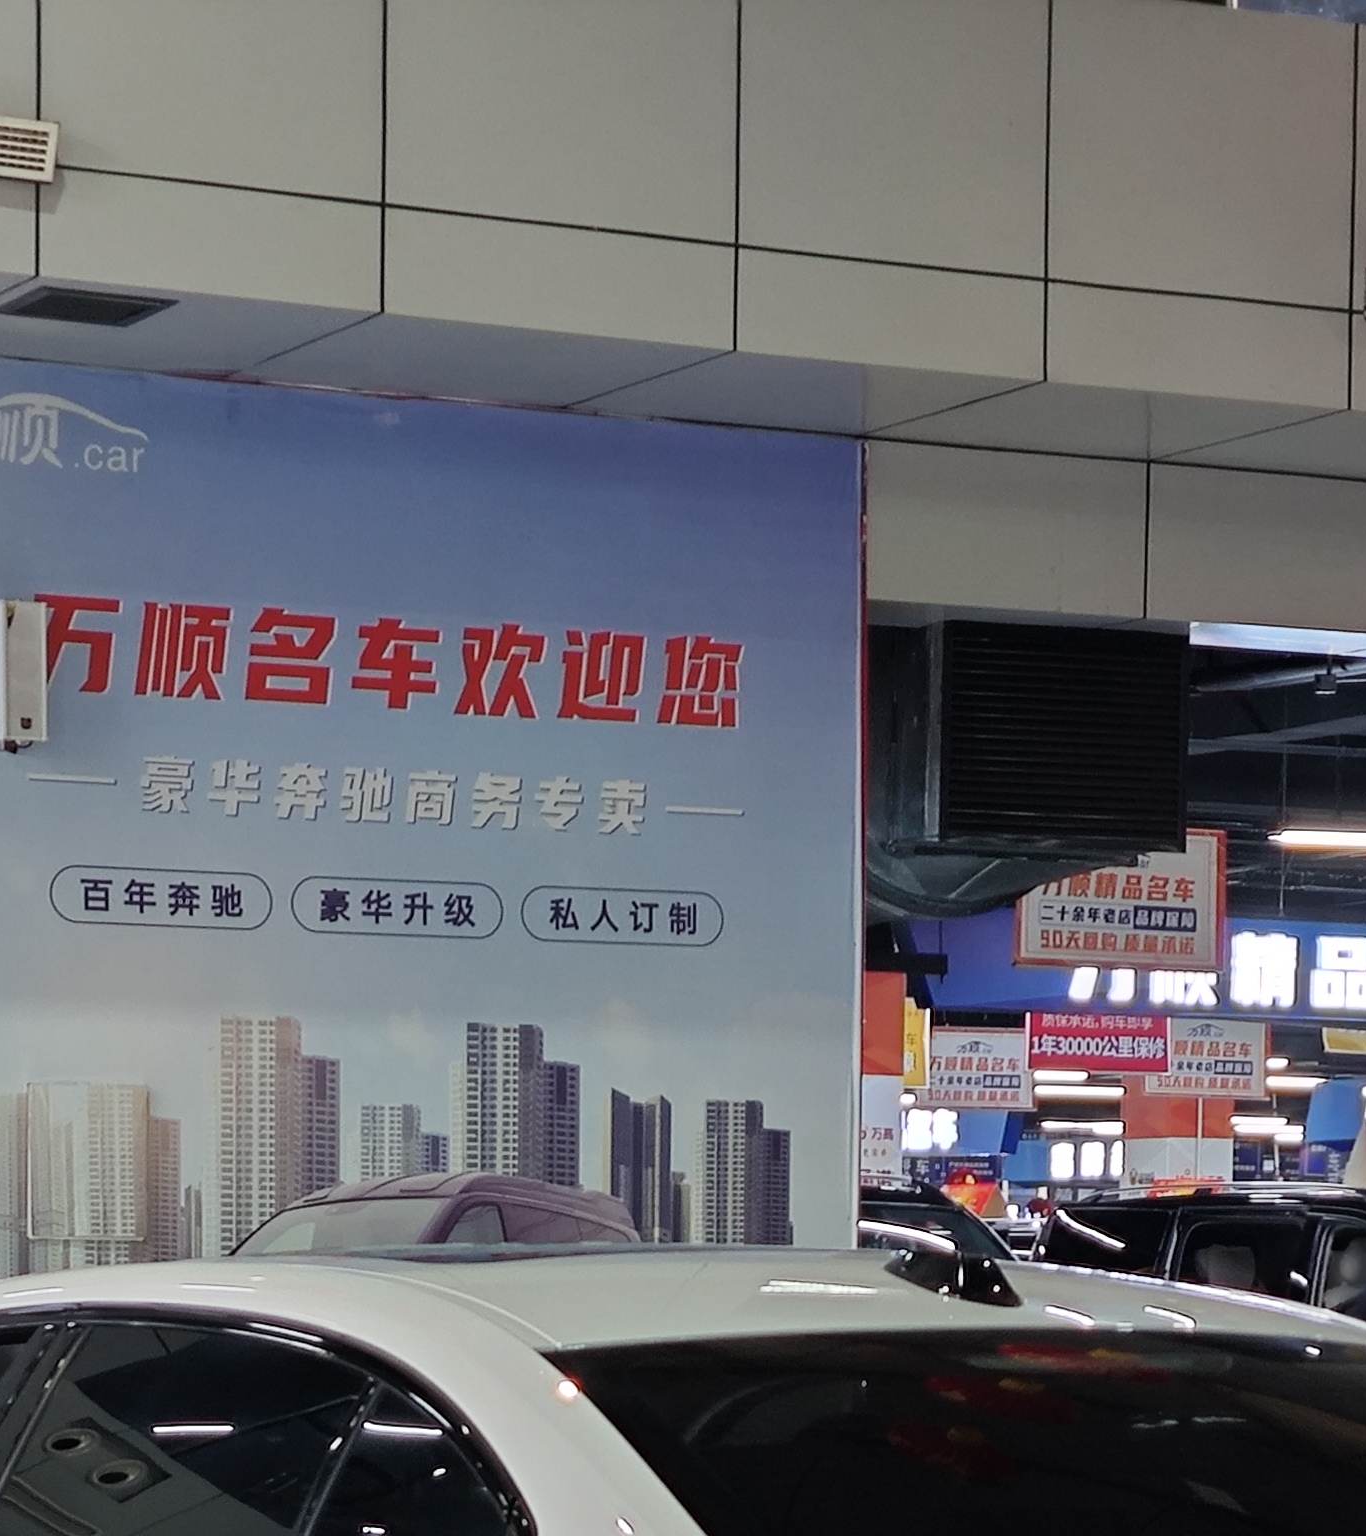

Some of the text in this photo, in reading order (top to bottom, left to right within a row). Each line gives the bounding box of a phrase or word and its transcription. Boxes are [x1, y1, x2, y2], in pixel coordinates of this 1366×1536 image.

[36, 593, 743, 729] 万顺名车欢迎您
[141, 754, 648, 836] 豪华奔驰商务专卖
[79, 877, 244, 919] 百年奔驰
[318, 887, 477, 930] 豪华升级
[548, 896, 698, 936] 私人订制
[1041, 904, 1131, 925] 二十余年老店
[1041, 930, 1117, 951] 90天回购
[1031, 1033, 1166, 1059] 1年30000公里保修
